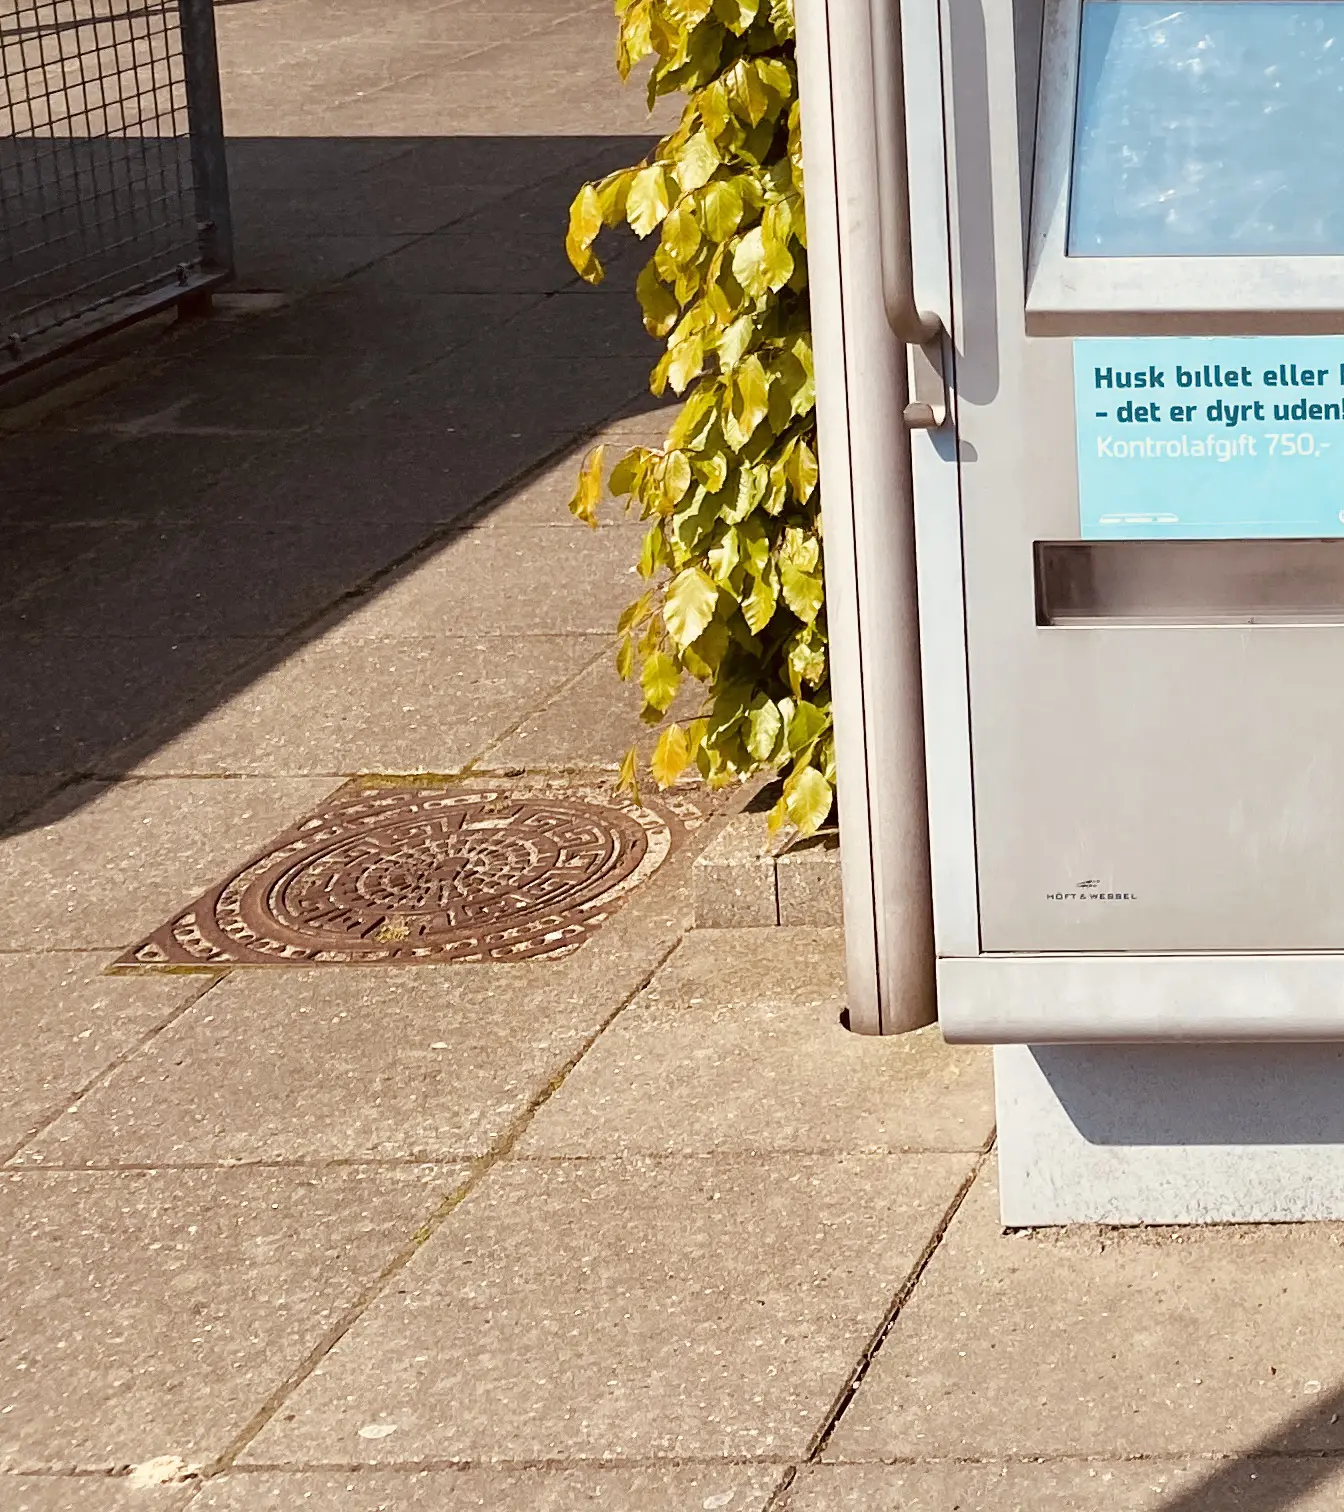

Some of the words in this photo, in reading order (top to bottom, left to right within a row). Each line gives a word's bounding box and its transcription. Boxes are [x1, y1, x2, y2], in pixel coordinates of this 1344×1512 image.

[1094, 366, 1165, 389] Husk
[1175, 365, 1252, 388] billet
[1262, 363, 1329, 387] eller
[1117, 400, 1161, 423] det
[1170, 403, 1198, 422] er
[1206, 399, 1266, 428] dyrt
[1097, 433, 1258, 463] Kontrolafgift
[1264, 433, 1332, 458] 750,-
